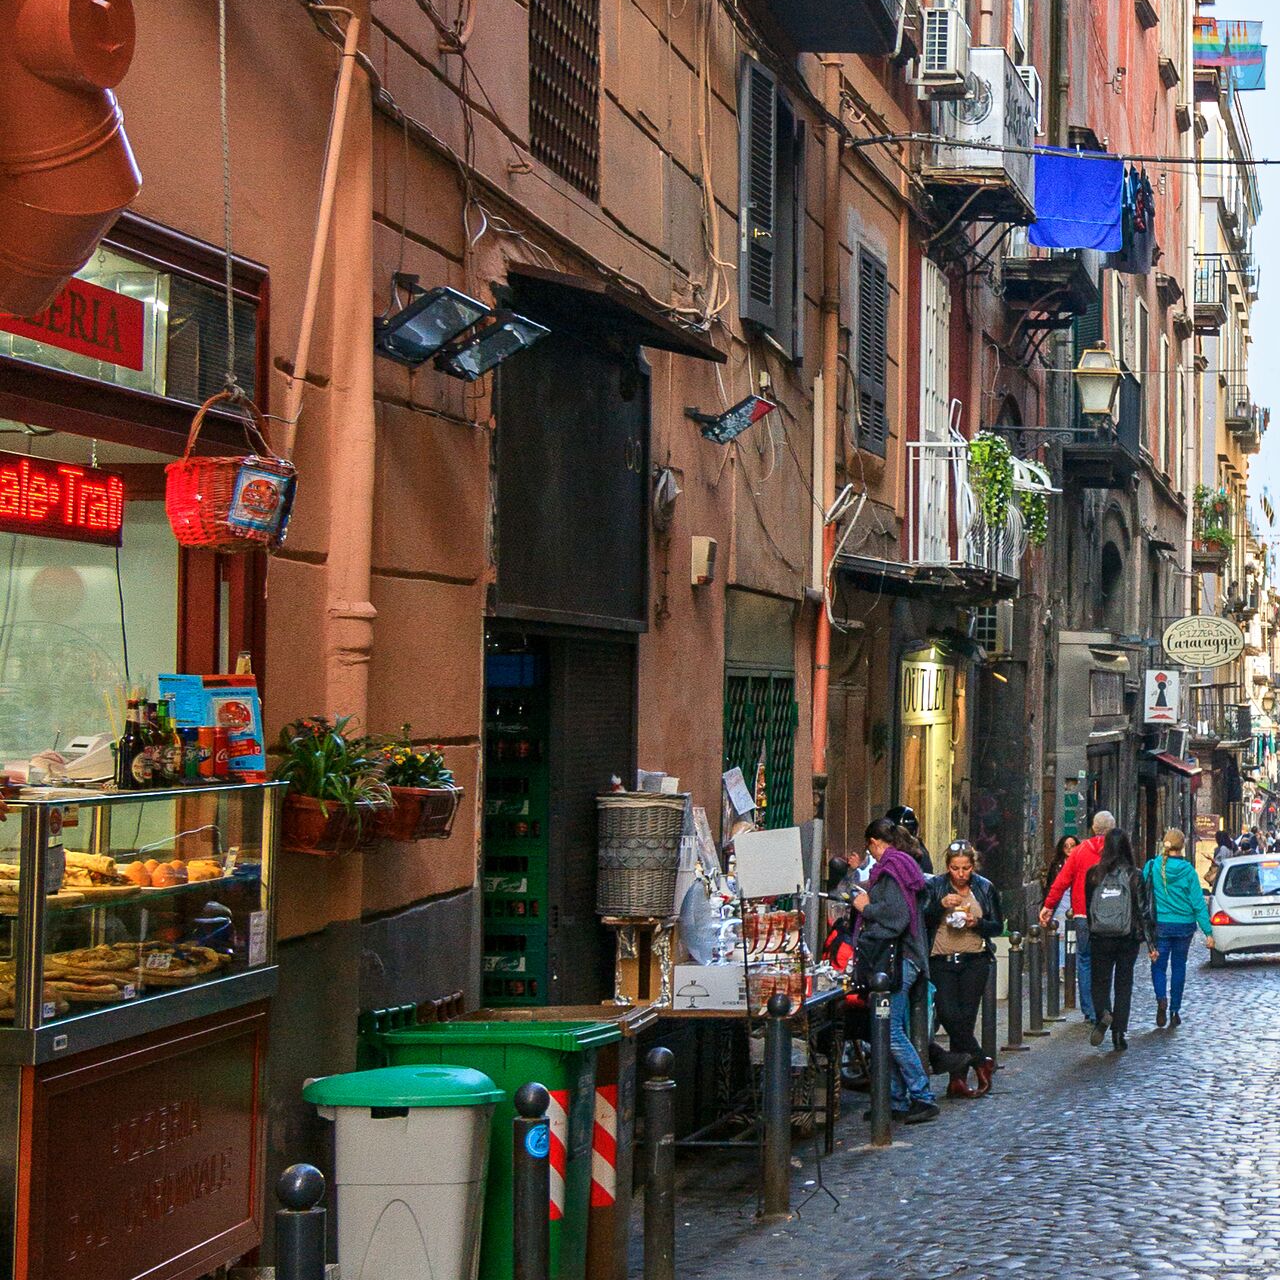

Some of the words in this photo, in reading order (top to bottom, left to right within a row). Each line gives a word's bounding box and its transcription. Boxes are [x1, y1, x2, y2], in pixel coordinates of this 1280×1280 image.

[1180, 629, 1226, 638] PIZZERIA
[1167, 634, 1240, 654] Caravaggio
[904, 667, 950, 713] OUTLET
